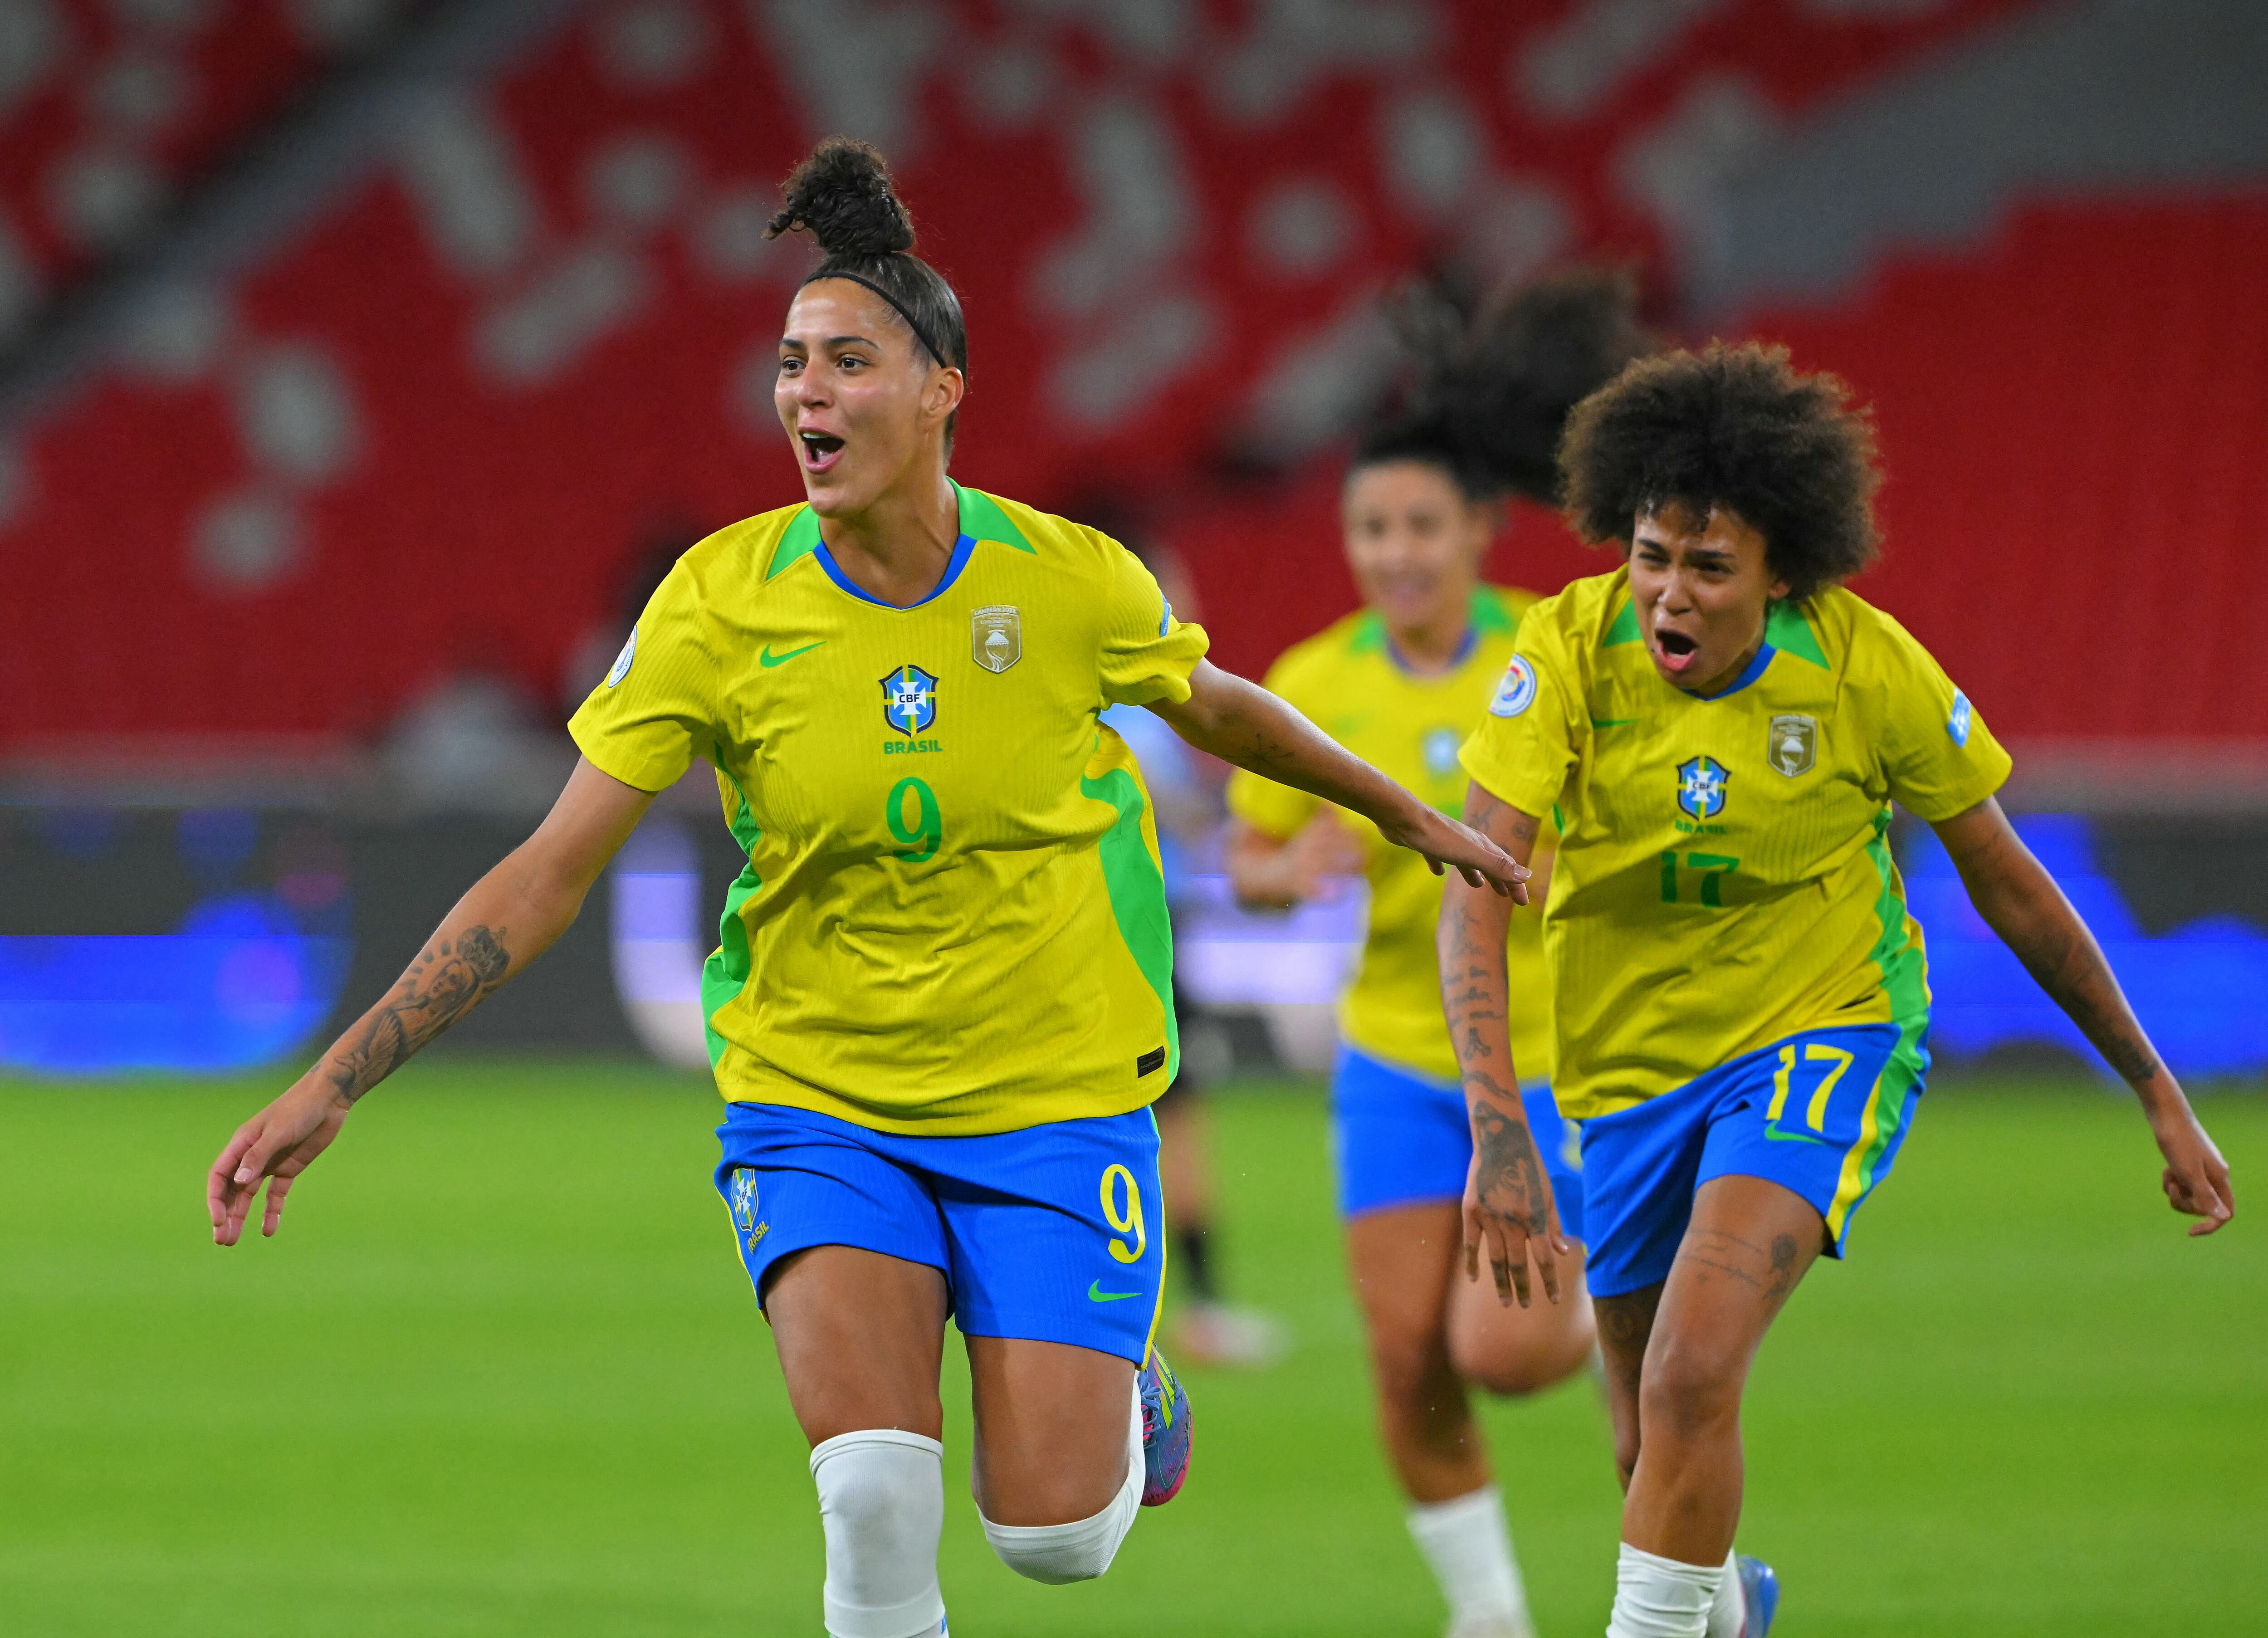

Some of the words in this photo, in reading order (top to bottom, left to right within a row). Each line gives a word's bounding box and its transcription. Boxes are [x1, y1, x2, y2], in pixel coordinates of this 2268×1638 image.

[899, 694, 920, 703] CBF
[883, 740, 943, 755] BRASIL
[886, 776, 942, 863] 9
[1661, 851, 1740, 908] 17
[1766, 1043, 1855, 1134] 17
[739, 1188, 748, 1203] CBF
[1100, 1164, 1146, 1264] 9
